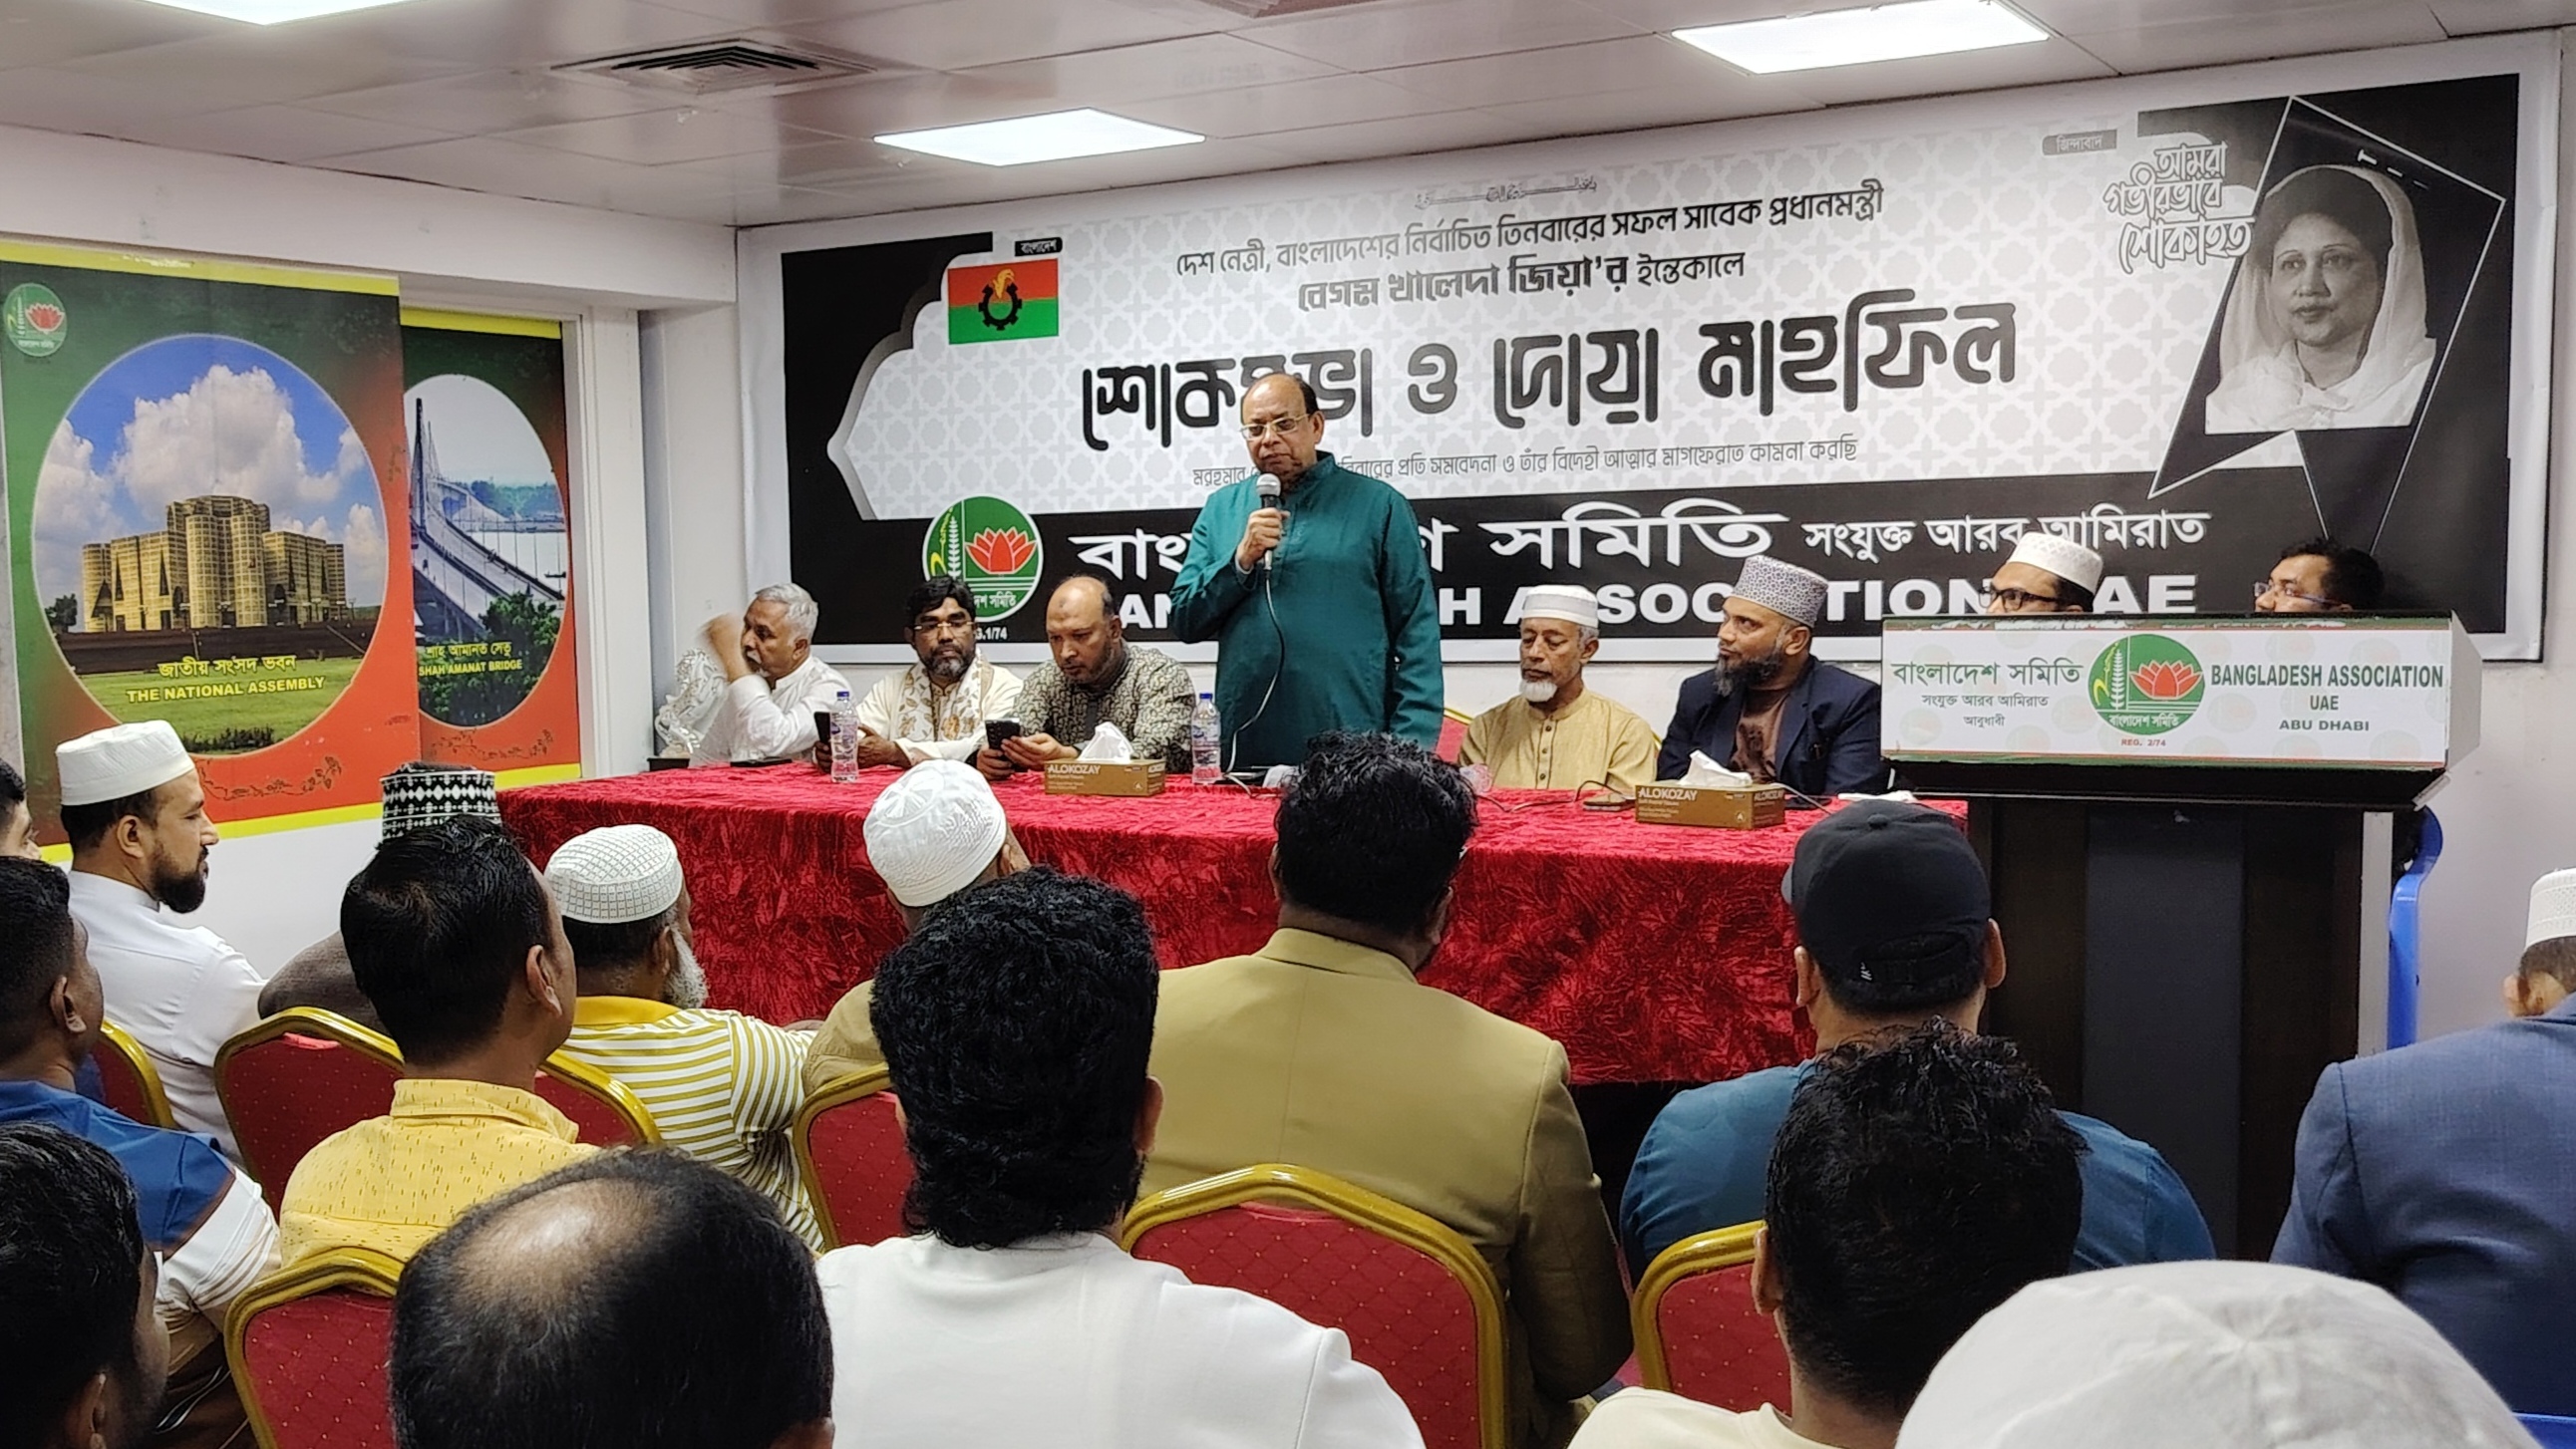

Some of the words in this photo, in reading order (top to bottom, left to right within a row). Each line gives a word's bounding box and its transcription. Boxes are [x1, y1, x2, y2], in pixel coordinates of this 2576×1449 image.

[2153, 141, 2229, 179] আমরা
[2102, 161, 2223, 218] গভীরভাবে
[1176, 251, 1215, 276] দেশ
[1220, 238, 1272, 273] নেত্রী,
[1276, 233, 1400, 266] বাংলাদেশের
[1406, 218, 1493, 255] নির্বাচিত
[1497, 213, 1605, 247] তিনবারের
[1612, 207, 1678, 238] সফল
[1684, 199, 1763, 230] সাবেক
[1770, 178, 1884, 226] প্রধানমন্ত্রী
[2119, 215, 2256, 274] শোকাহত
[1298, 278, 1381, 312] বেগম
[1389, 263, 1500, 302] খালেদা
[1638, 252, 1746, 287] ইন্তেকালে
[1408, 343, 1458, 416] ও
[1493, 327, 1659, 430] দোয়া
[1698, 288, 2017, 417] মাহফিল
[1398, 452, 1427, 476] প্রতি
[1430, 454, 1496, 476] সমবেদনা
[1502, 455, 1514, 473] ও
[1519, 447, 1547, 472] তাঁর
[1552, 445, 1599, 472] বিদেহী
[1604, 447, 1657, 471] আত্মার
[1662, 443, 1746, 467] মাগফেরাত
[1750, 440, 1804, 463] কামনা
[1808, 434, 1858, 460] করছি
[1477, 498, 1790, 570] সমিতি
[1801, 519, 1916, 563] সংযুক্ত
[1924, 514, 2031, 554] আরব
[2038, 502, 2212, 551] আমিরাত
[2093, 574, 2198, 615] AE
[448, 643, 488, 657] আমানত
[490, 641, 512, 658] সেতু
[157, 656, 210, 678] জাতীয়
[213, 655, 258, 675] সংসদ
[261, 655, 297, 672] ভবন
[419, 666, 446, 677] SHAH
[448, 662, 487, 675] AMANAT
[488, 660, 522, 672] BRIDGE
[1890, 662, 2001, 686] বাংলাদেশ
[2007, 657, 2085, 686] সমিতি
[2211, 665, 2323, 687] BANGLADESH
[2327, 665, 2443, 688] ASSOCIATION
[126, 690, 161, 703] THE
[164, 683, 244, 701] NATIONAL
[248, 677, 325, 694] ASSEMBLY
[1921, 695, 1959, 709] সংযুক্ত
[1961, 695, 1994, 708] আরব
[1997, 693, 2050, 708] আমিরাত
[2310, 696, 2340, 711] UAE
[2279, 720, 2313, 730] ABU
[2318, 721, 2370, 731] DHABI
[1047, 763, 1102, 775] ALOKOZAY
[1638, 786, 1698, 801] ALOKOZAY
